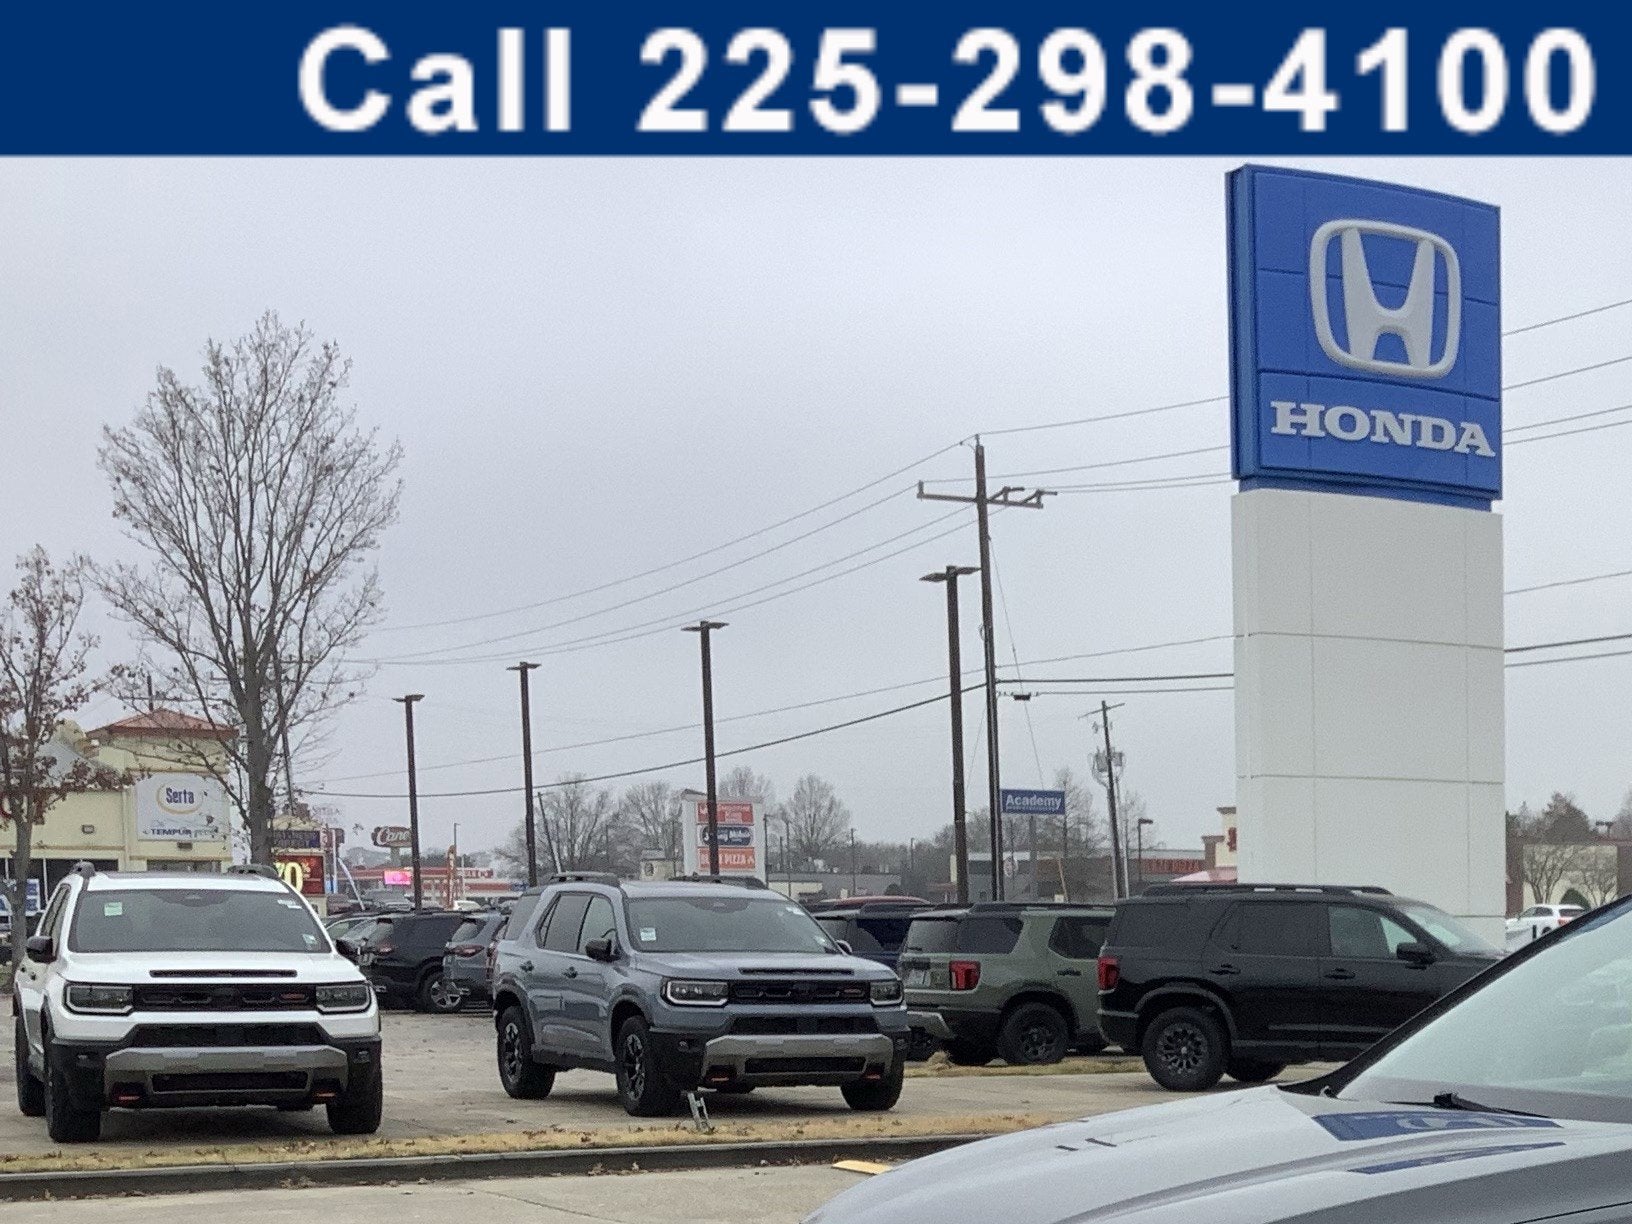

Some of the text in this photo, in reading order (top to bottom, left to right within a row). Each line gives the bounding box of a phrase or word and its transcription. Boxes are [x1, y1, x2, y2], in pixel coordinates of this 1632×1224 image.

[1270, 401, 1496, 457] HONDA
[165, 787, 195, 805] Serta
[1005, 794, 1062, 810] Academy
